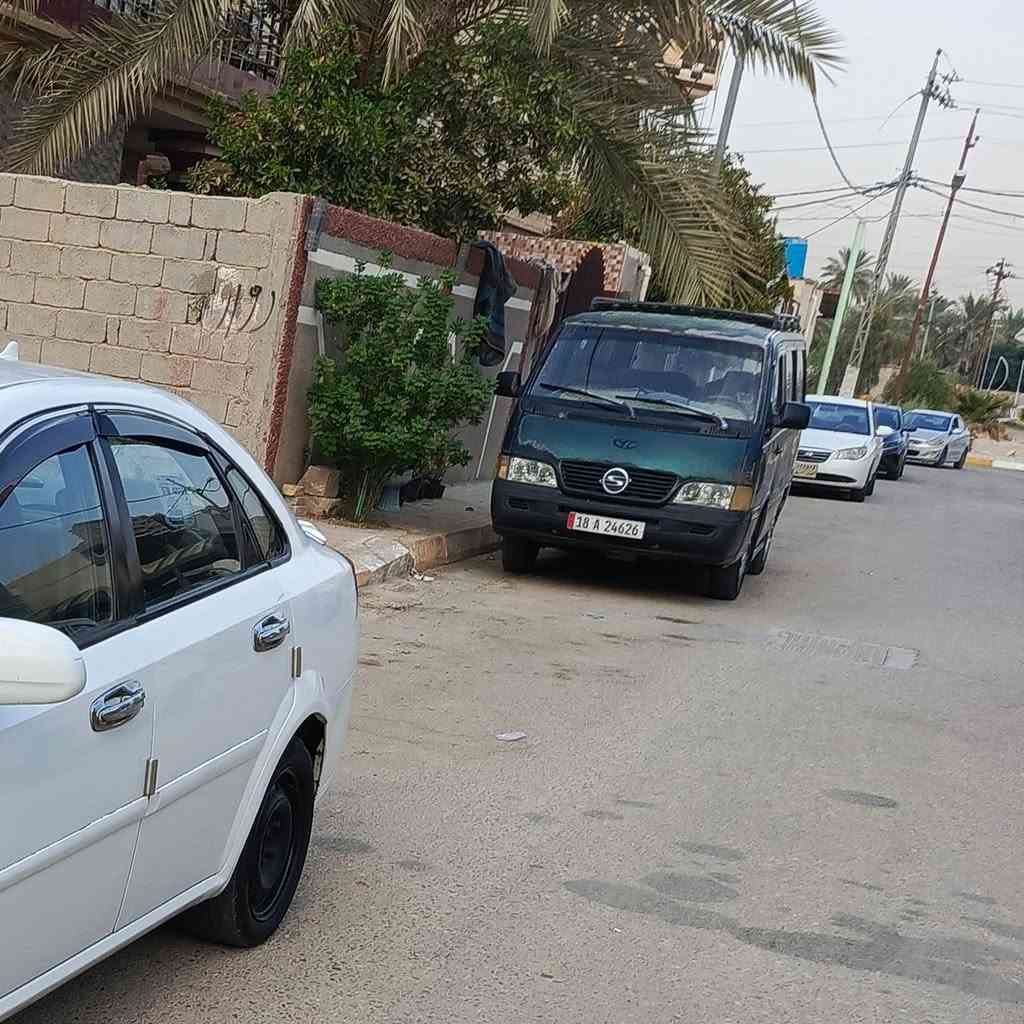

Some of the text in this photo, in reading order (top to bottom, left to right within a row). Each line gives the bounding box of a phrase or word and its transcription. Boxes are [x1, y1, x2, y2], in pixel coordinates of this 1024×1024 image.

[576, 515, 590, 529] 18
[593, 519, 600, 530] A
[604, 520, 639, 536] 24626
